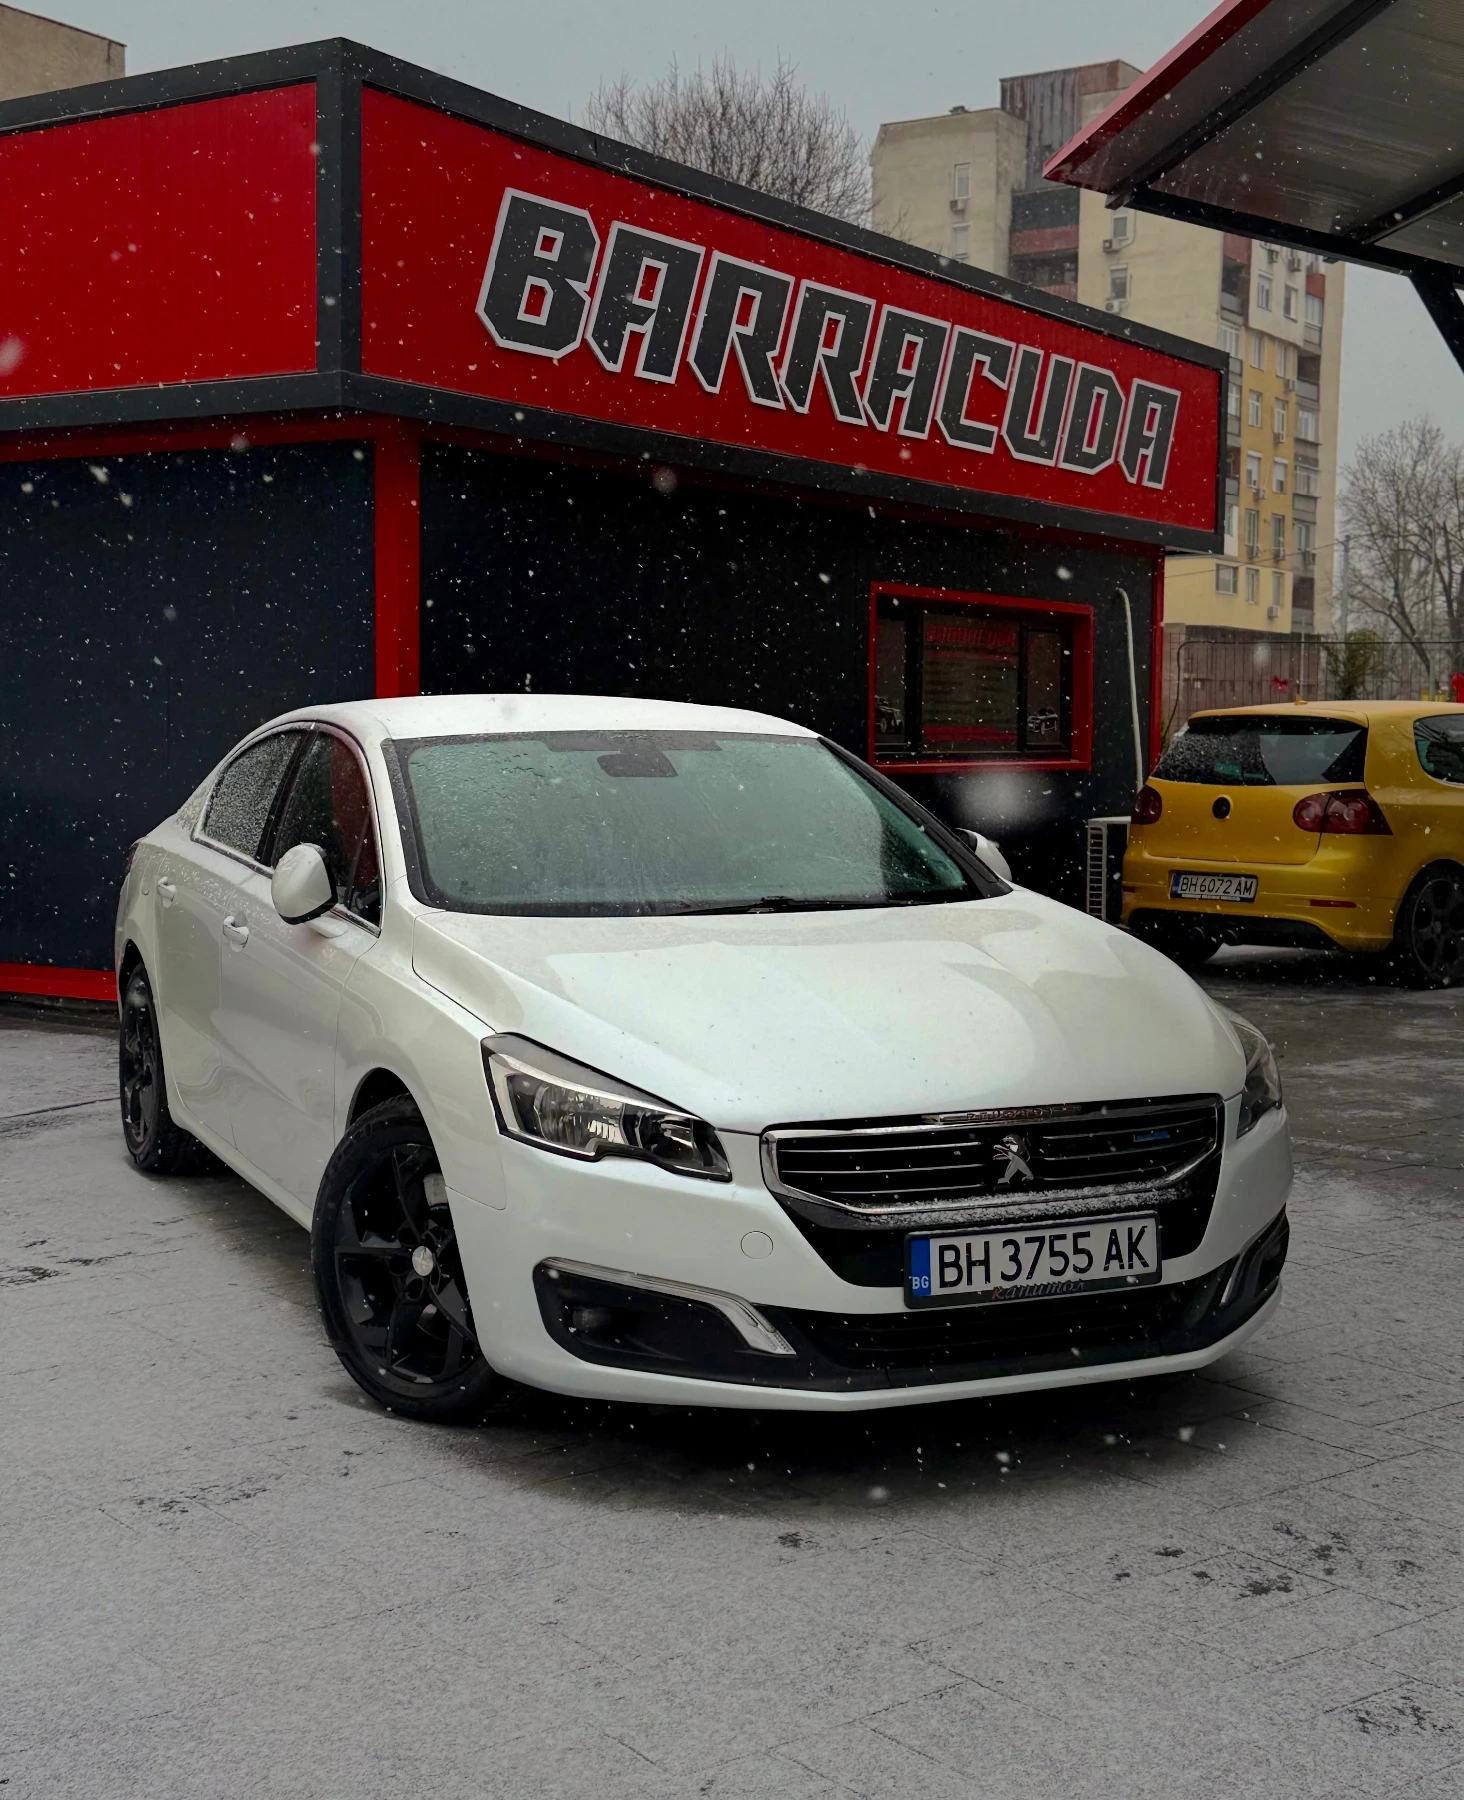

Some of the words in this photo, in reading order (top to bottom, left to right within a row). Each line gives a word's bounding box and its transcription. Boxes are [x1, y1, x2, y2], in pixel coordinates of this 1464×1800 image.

[476, 186, 1181, 491] BARRACUDA
[1180, 876, 1198, 893] BH
[1199, 878, 1232, 895] 6072
[1233, 879, 1254, 897] AM
[938, 1240, 991, 1289] BH
[1000, 1231, 1094, 1282] 3755
[1102, 1225, 1150, 1272] AK
[912, 1275, 930, 1290] BG
